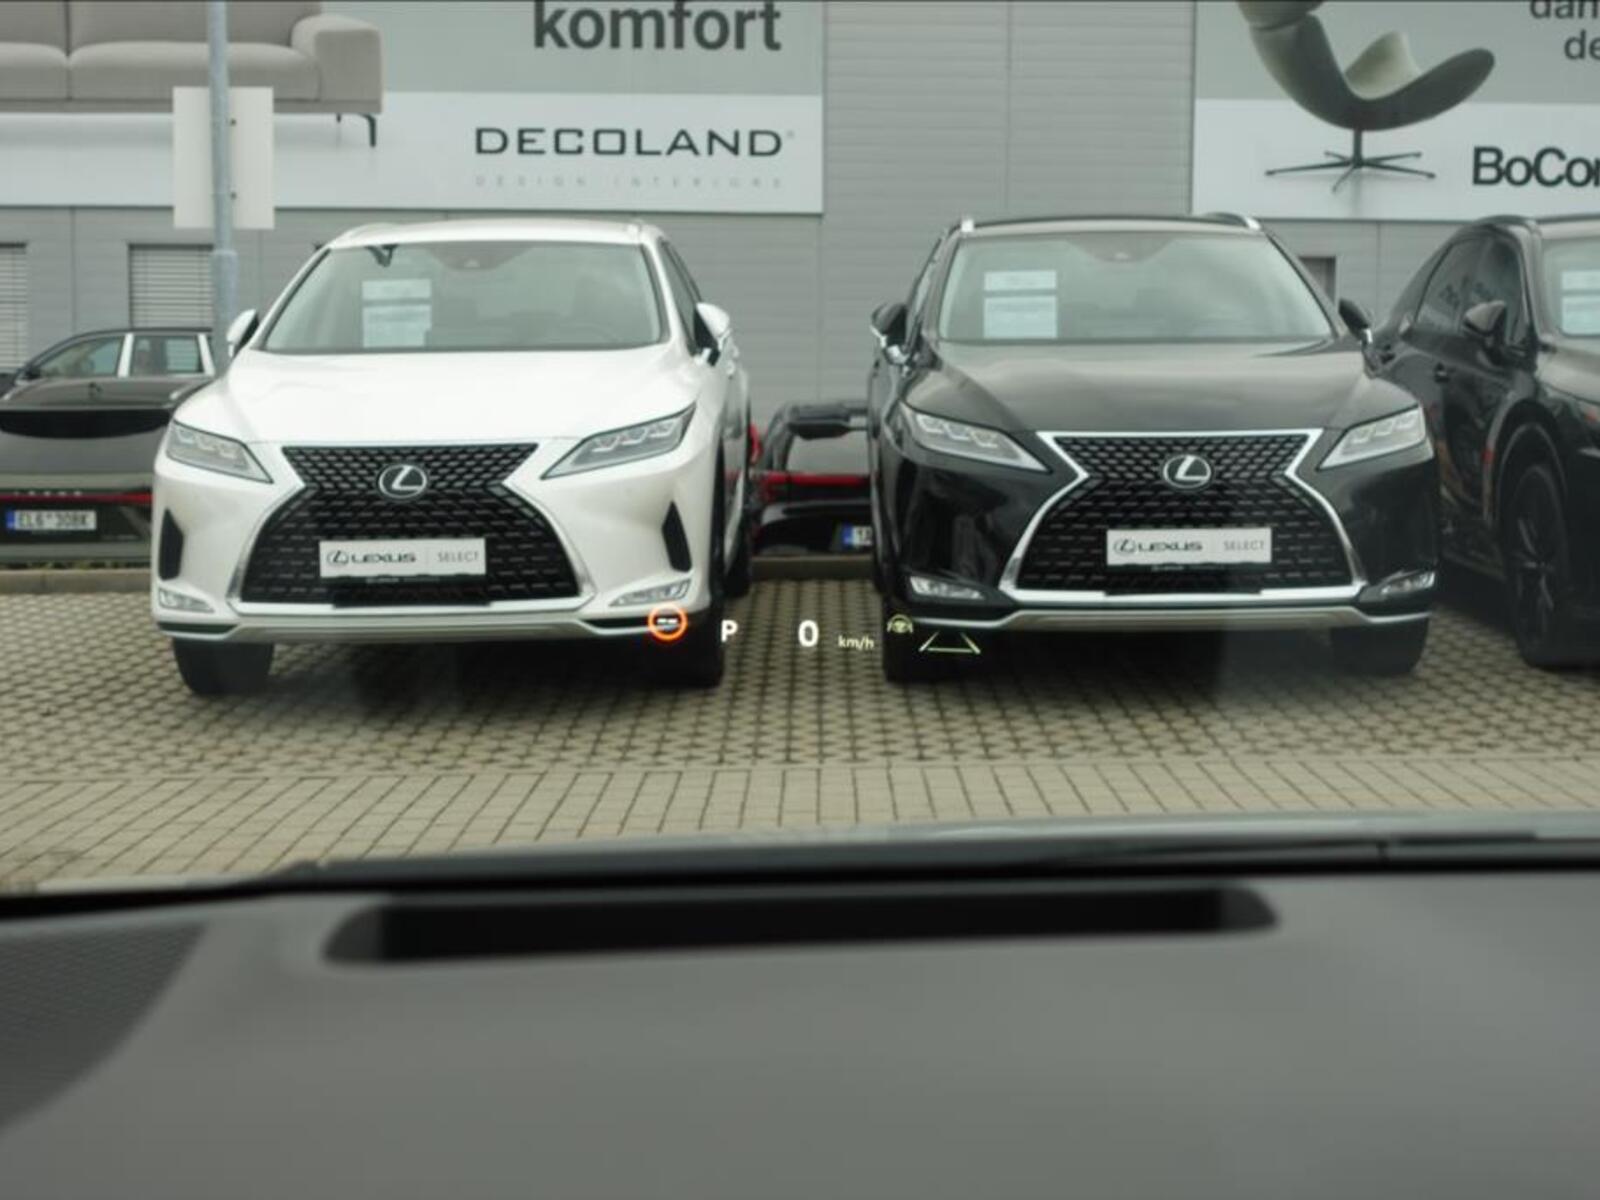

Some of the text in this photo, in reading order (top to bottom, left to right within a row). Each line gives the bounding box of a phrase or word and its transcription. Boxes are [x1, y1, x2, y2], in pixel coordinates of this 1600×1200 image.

[533, 0, 782, 51] komfort
[475, 127, 783, 157] DECOLAND
[1472, 146, 1600, 188] BoCo
[351, 550, 478, 563] LEXUS SELECT
[1138, 540, 1265, 552] LEXUS SELECT
[720, 620, 874, 651] P 0 km/h
